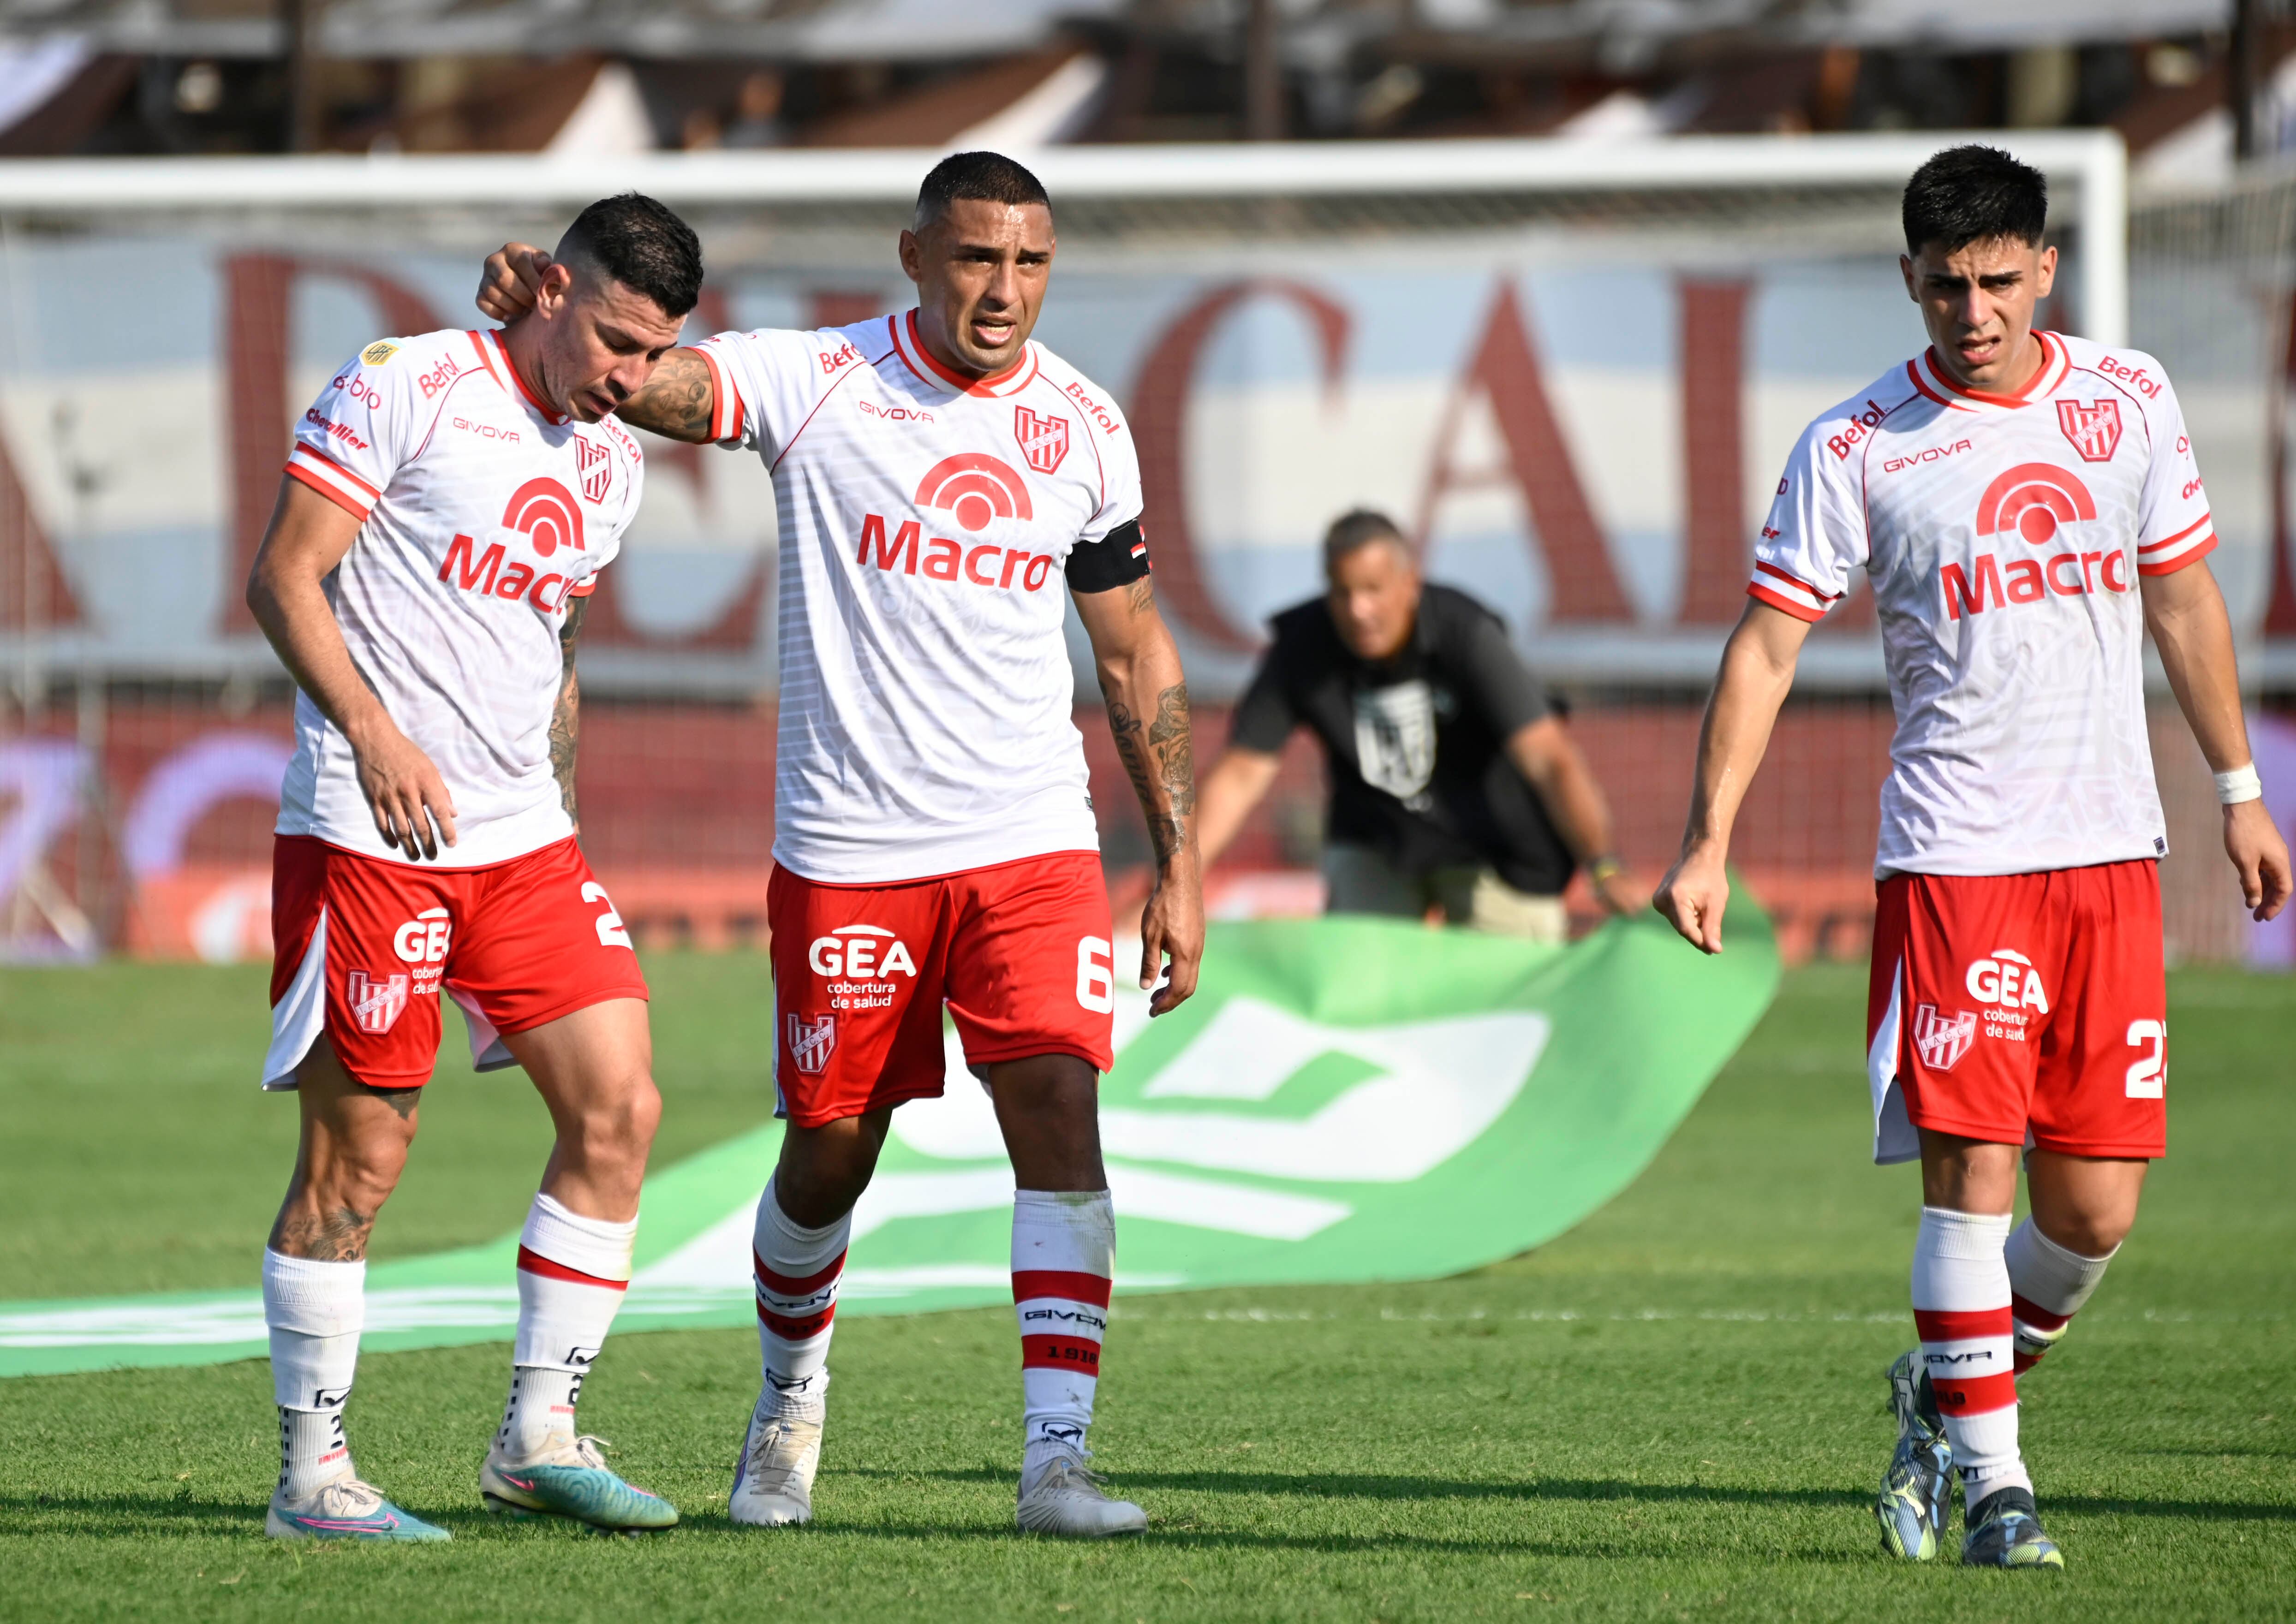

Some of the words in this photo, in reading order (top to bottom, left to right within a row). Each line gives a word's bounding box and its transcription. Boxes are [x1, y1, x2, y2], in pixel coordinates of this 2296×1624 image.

[417, 352, 460, 399] Befol
[2098, 356, 2162, 399] Befol
[305, 408, 369, 450] Chevallier
[859, 401, 934, 423] GIVOVA
[1066, 382, 1120, 434] Befol
[453, 417, 519, 444] GIVOVA
[1827, 399, 1886, 460] Befol
[1884, 440, 1972, 473] GIVOVA
[857, 513, 1053, 592] Macro
[1940, 549, 2126, 621] Macro
[809, 936, 917, 978] GEA
[1076, 935, 1114, 1014] 6
[413, 982, 425, 994] de
[827, 981, 896, 994] cobertura
[831, 996, 849, 1009] de
[853, 994, 892, 1009] salud
[1966, 959, 2049, 1015] GEA
[1986, 1023, 2004, 1038] de
[1025, 1309, 1106, 1331] GIVOV
[1048, 1346, 1097, 1364] 1918
